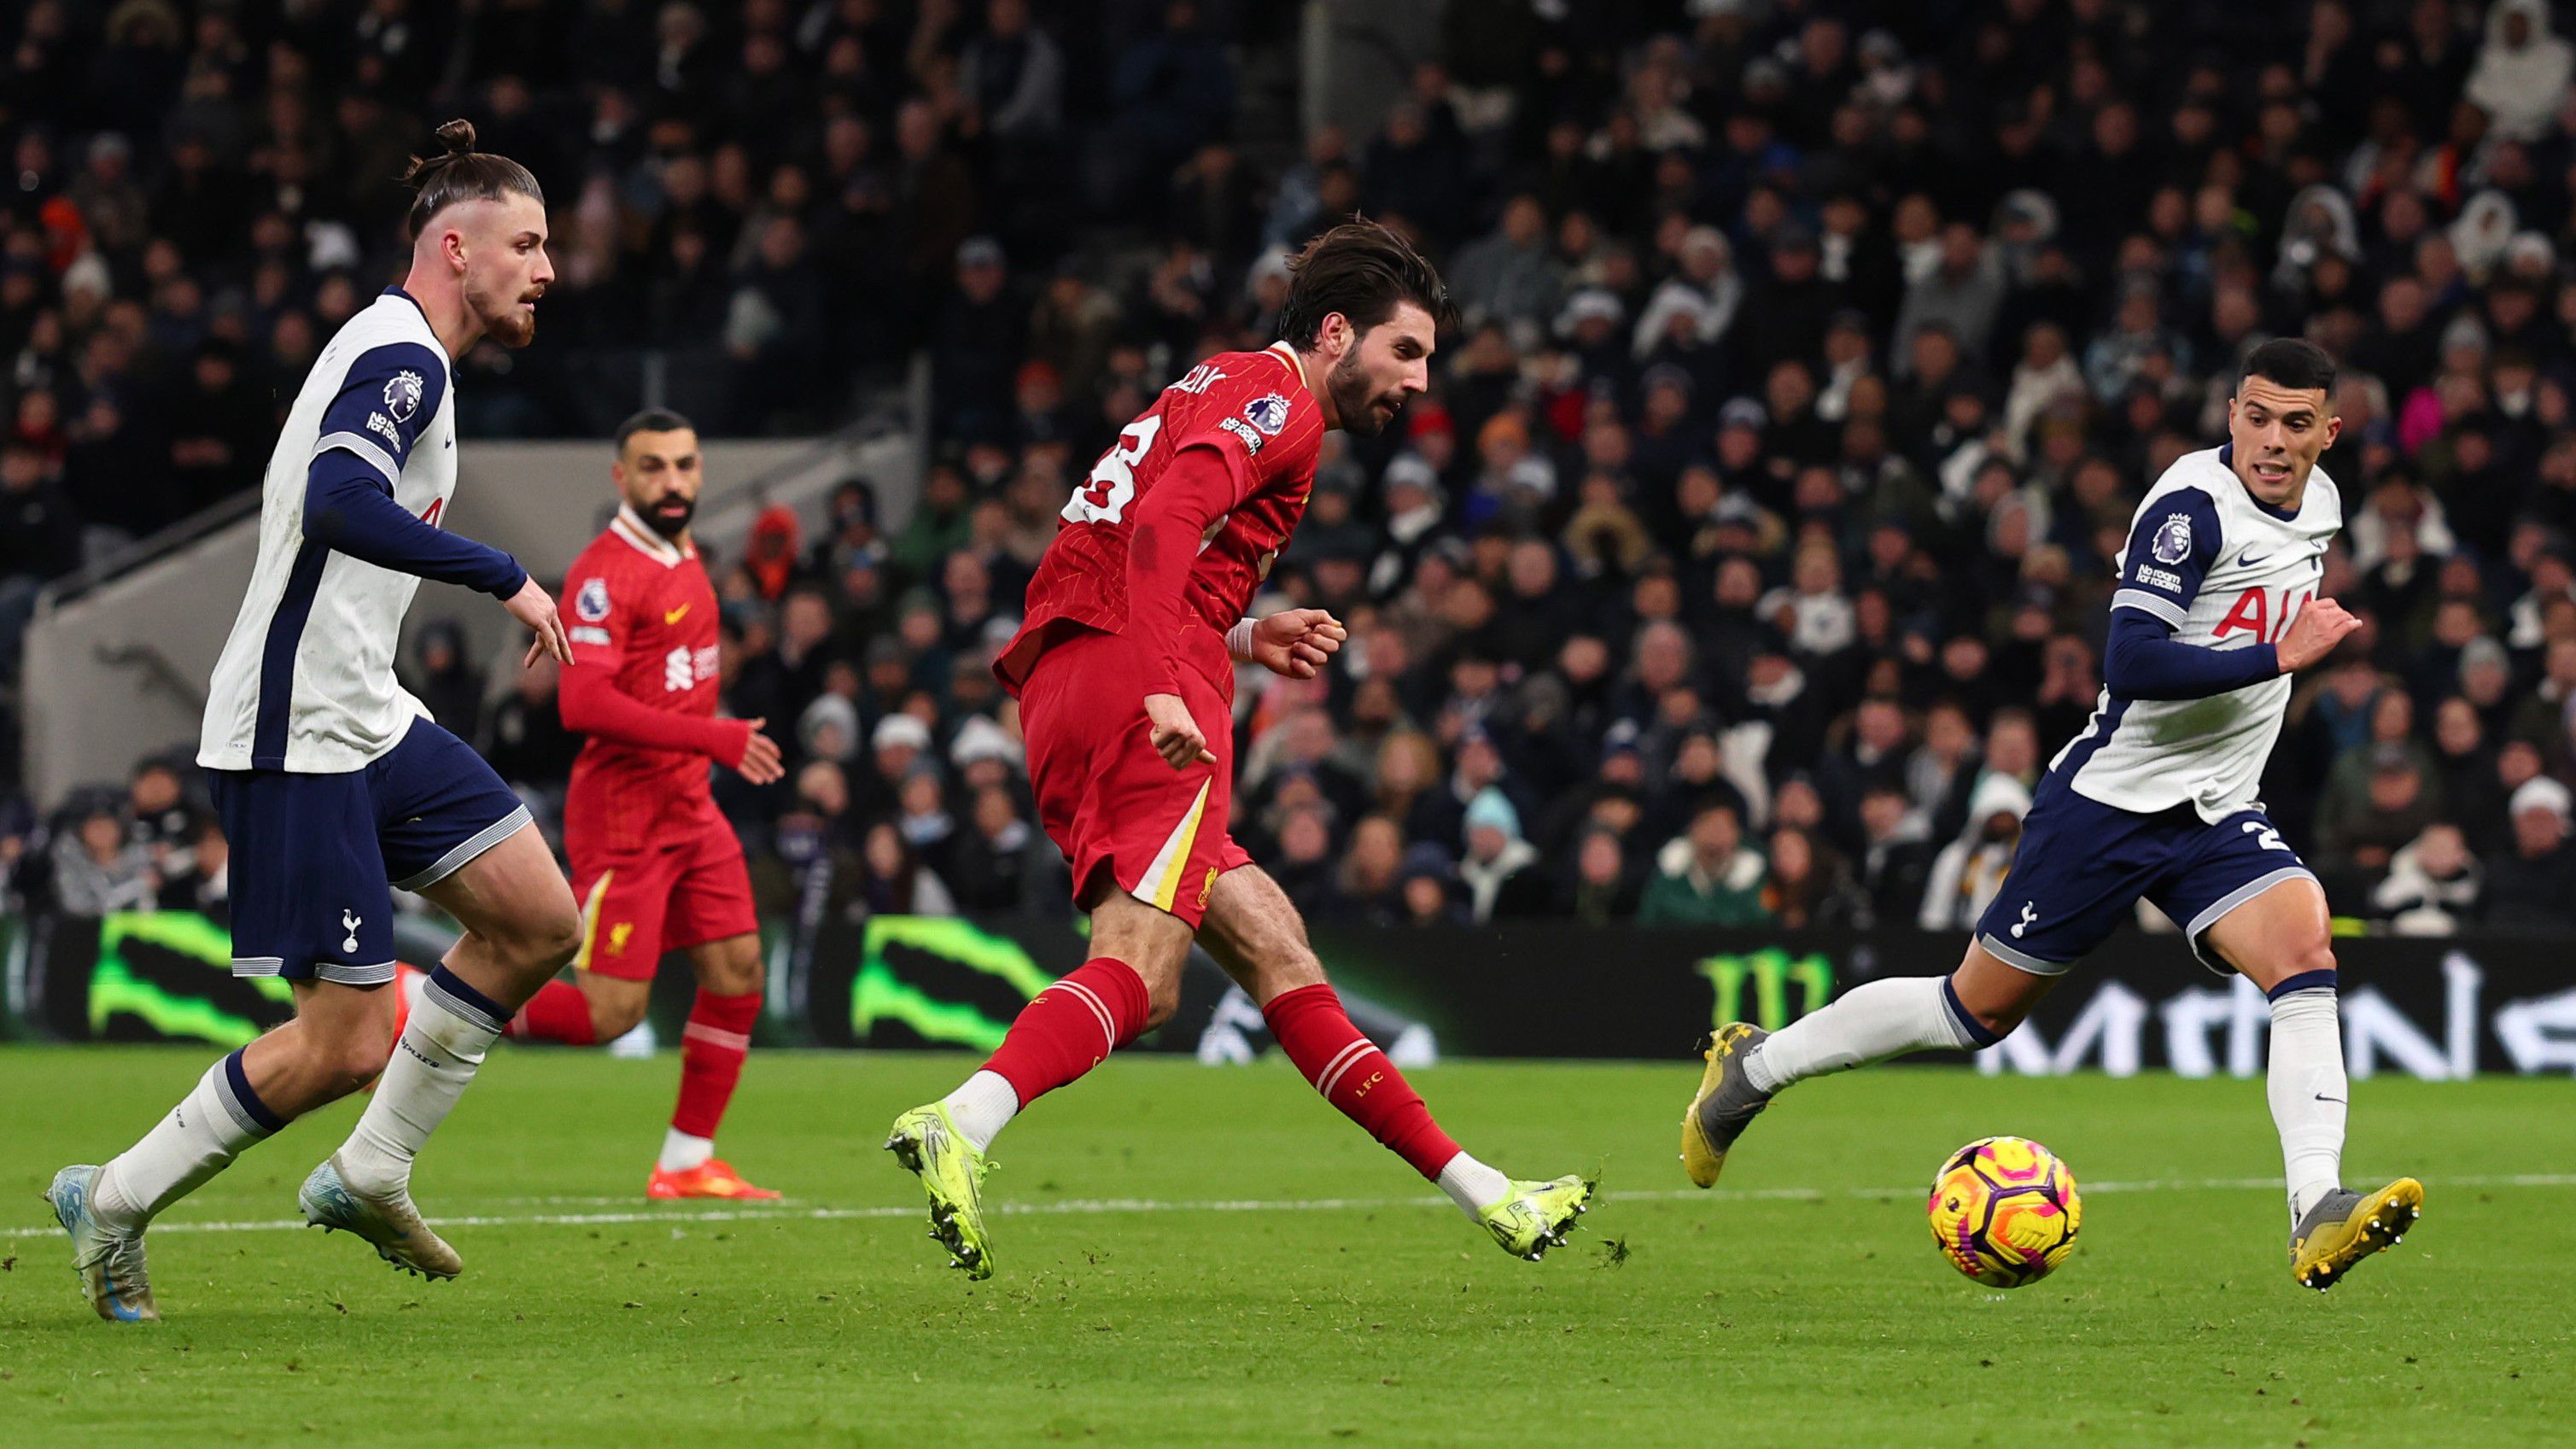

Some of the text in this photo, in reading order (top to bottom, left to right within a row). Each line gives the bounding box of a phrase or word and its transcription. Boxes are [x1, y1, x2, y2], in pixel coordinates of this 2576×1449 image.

[370, 412, 387, 425] No
[1221, 418, 1262, 447] No room
[1234, 428, 1256, 456] racism
[2135, 574, 2182, 593] for racism
[2138, 564, 2181, 585] No room
[2211, 586, 2311, 645] AI
[2241, 821, 2304, 865] 2
[1355, 1071, 1384, 1097] LFC
